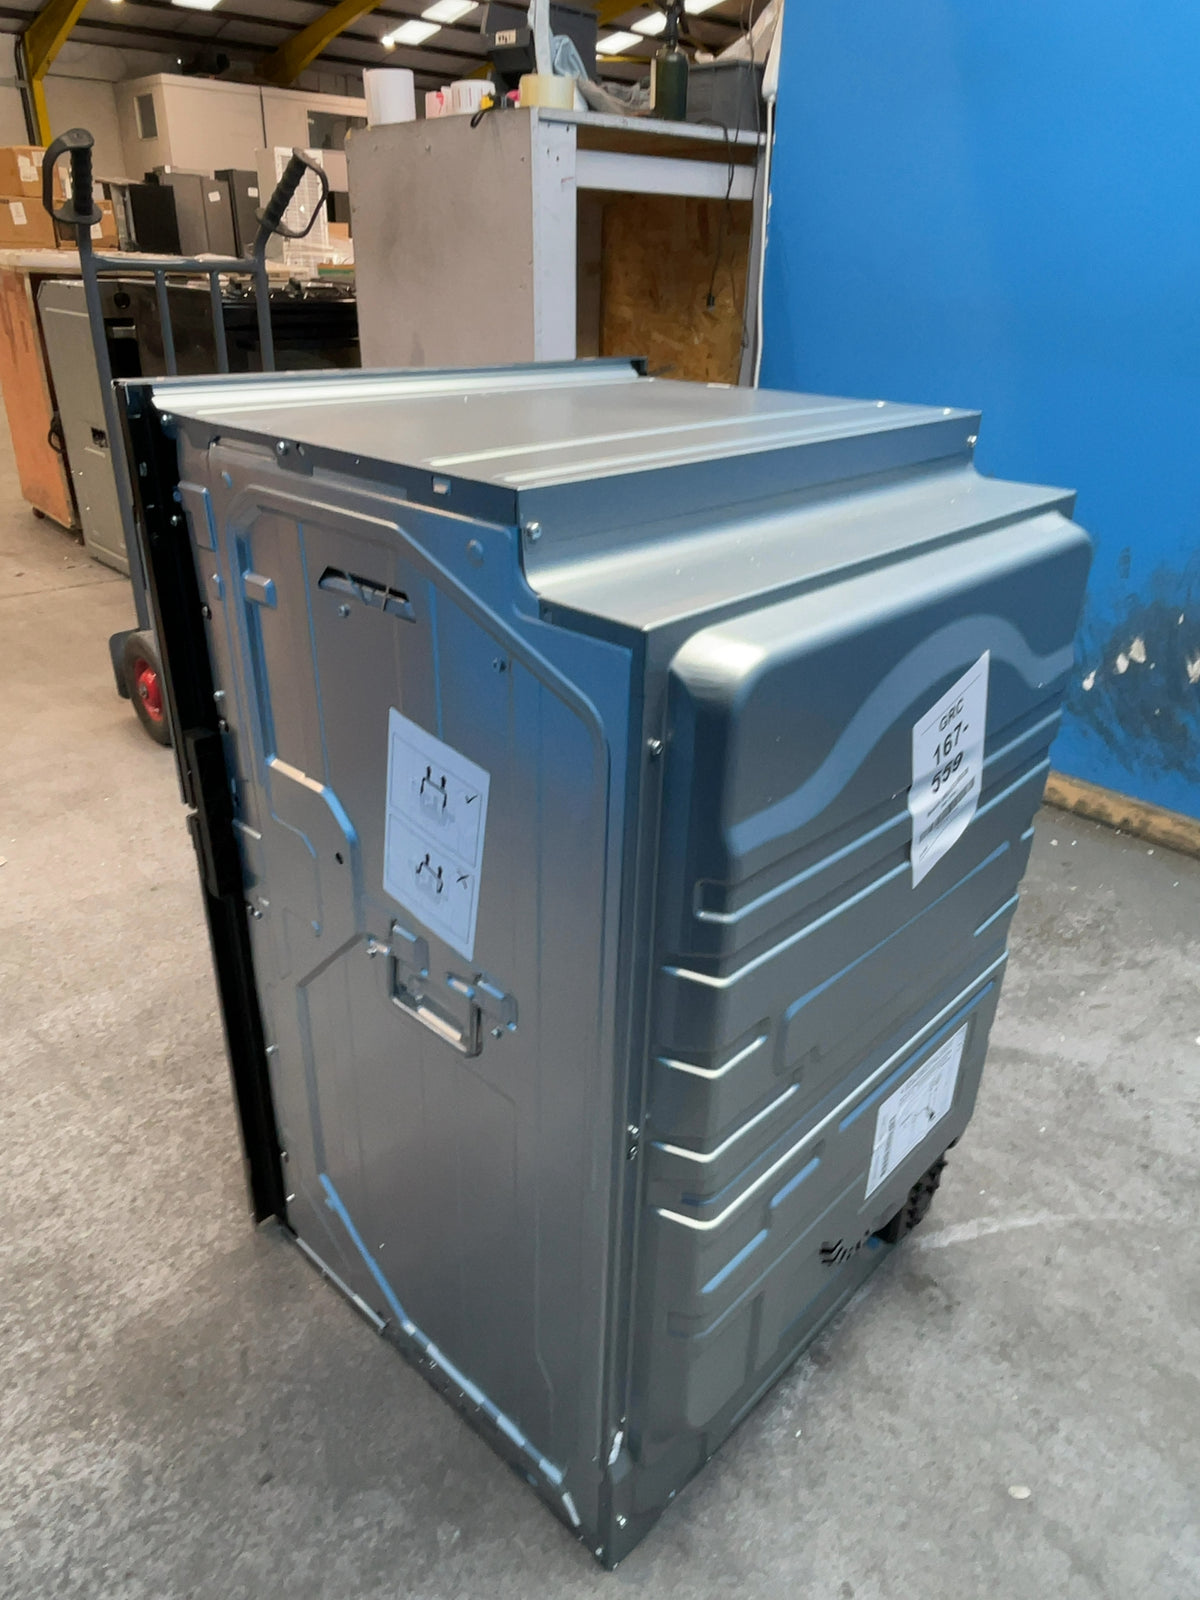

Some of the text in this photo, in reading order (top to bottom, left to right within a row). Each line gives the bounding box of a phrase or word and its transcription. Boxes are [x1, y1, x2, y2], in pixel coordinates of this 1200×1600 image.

[939, 698, 964, 732] GRC
[932, 721, 969, 766] 167-
[931, 750, 964, 793] 559
